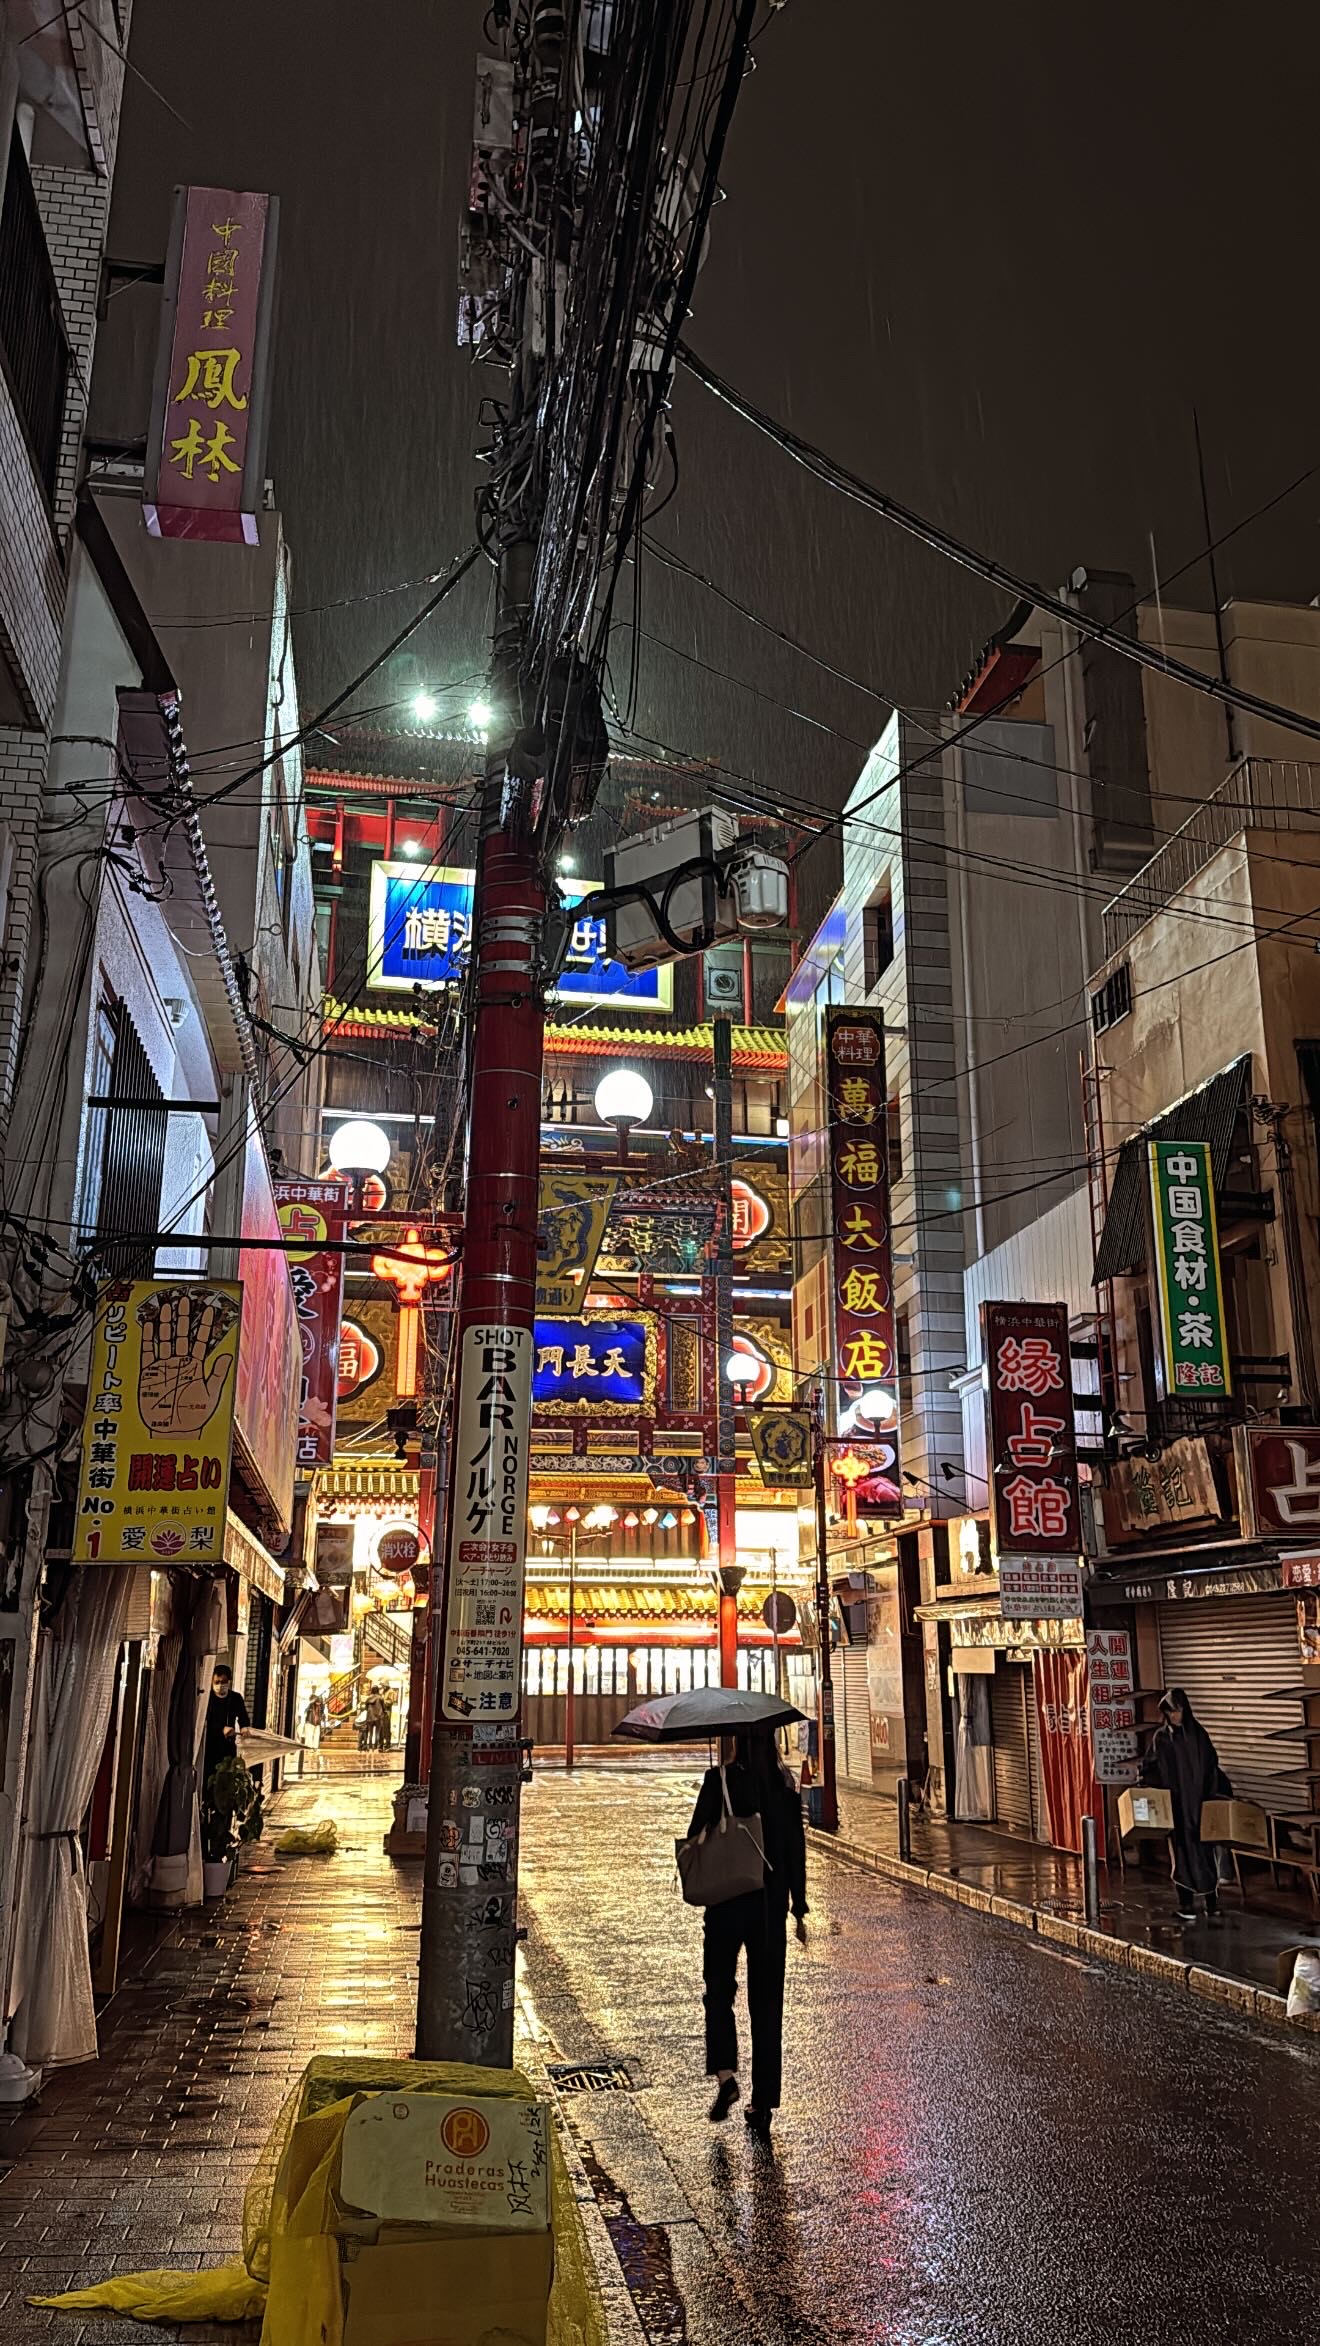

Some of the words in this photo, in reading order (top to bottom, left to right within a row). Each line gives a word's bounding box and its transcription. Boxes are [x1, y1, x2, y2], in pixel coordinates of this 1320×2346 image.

[169, 347, 248, 483] 鳳林
[838, 1029, 874, 1045] 中華
[837, 1045, 874, 1061] 料理
[838, 1077, 888, 1380] 萬福大飯店
[1166, 1151, 1214, 1348] 中国食材・茶
[473, 1329, 525, 1348] SHOT
[1175, 1362, 1223, 1386] 隆記
[476, 1347, 517, 1430] BAR
[997, 1336, 1070, 1537] 縁占館
[127, 1453, 223, 1492] 開運占い
[500, 1435, 519, 1535] NORGE
[121, 1526, 147, 1551] 愛
[190, 1526, 214, 1552] 梨
[381, 1541, 417, 1559] 消火栓
[462, 1565, 513, 1576] ノーチャージ
[456, 1646, 510, 1656] 045-641-7020
[473, 1670, 514, 1681] 地図と案内
[1088, 1634, 1112, 1730] 人生相談
